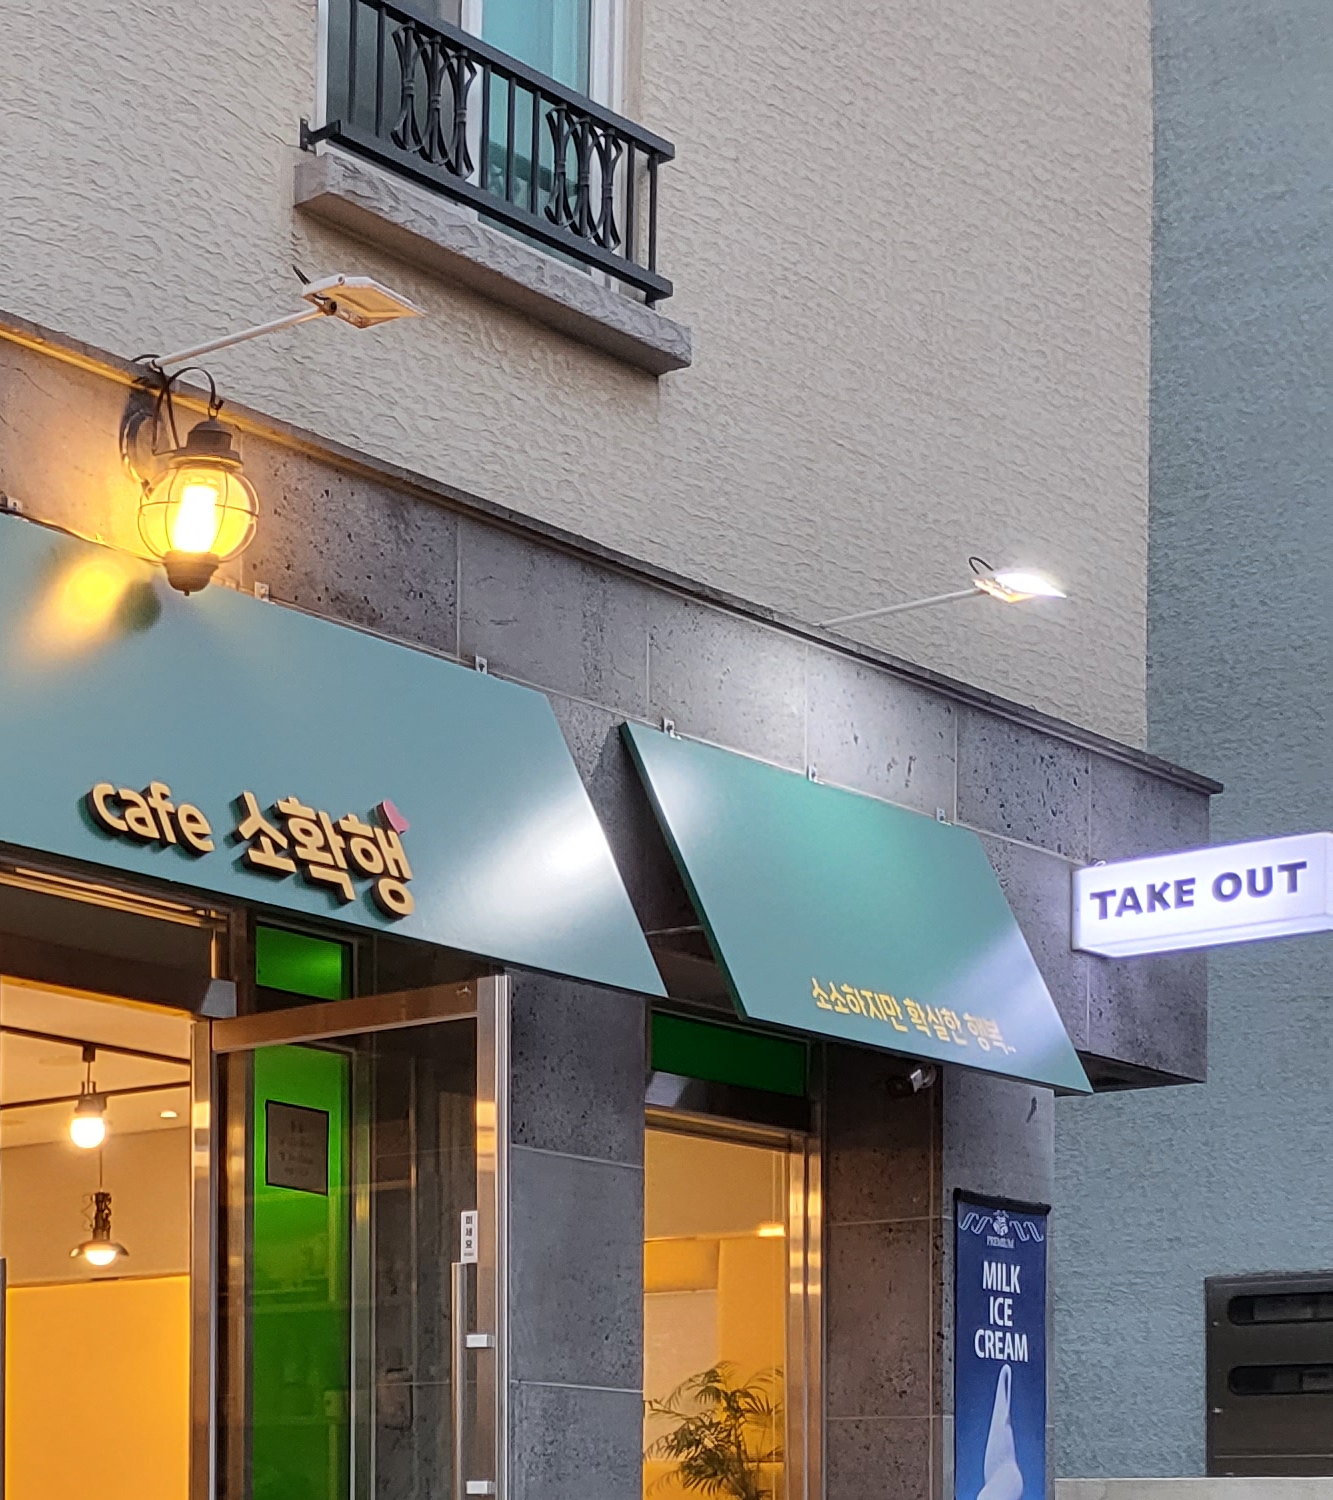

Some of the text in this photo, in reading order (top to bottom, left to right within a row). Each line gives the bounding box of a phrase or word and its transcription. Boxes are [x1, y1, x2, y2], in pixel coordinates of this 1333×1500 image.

[89, 780, 416, 918] cafe 소확행
[1090, 861, 1308, 920] TAKE OUT
[811, 976, 909, 1032] 소소하지만
[902, 997, 968, 1046] 확실한
[982, 1260, 1021, 1294] MILK
[989, 1297, 1013, 1327] ICE
[974, 1329, 1029, 1363] CREAM
